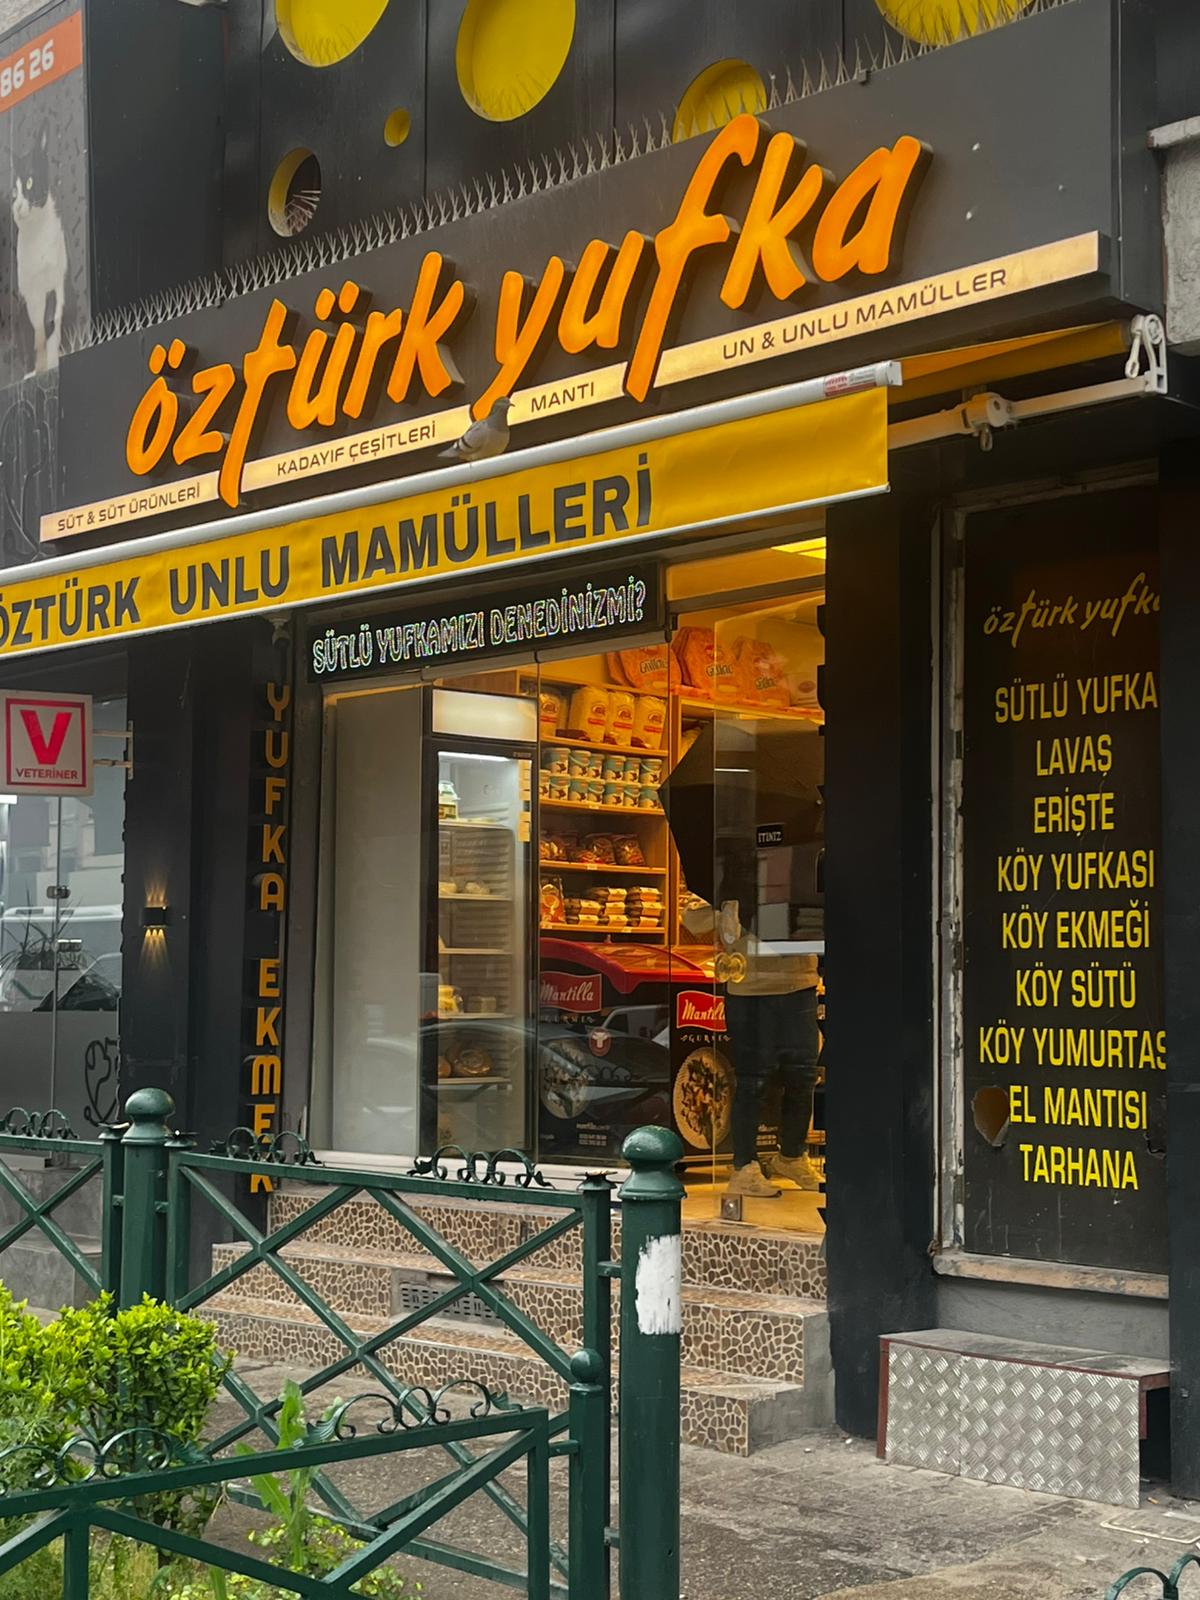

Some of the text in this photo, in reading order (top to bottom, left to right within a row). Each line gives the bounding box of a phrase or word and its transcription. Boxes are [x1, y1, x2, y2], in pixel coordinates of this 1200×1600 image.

[1, 39, 55, 98] 86 26
[126, 113, 921, 508] öztürk yufka
[723, 268, 1008, 360] UN & UNLU MAMÜLLER
[530, 382, 595, 413] MANTI
[277, 420, 436, 476] KADAYIF ÇEŞİTLERİ
[57, 481, 201, 532] SÜT & SÜT ÜRÜNLERİ
[168, 545, 290, 616] UNLU
[321, 452, 652, 588] MAMÜLLERİ
[312, 623, 373, 675] SÜTLÜ
[376, 610, 485, 664] YUFKAMIZI
[983, 588, 1079, 649] öztürk
[995, 671, 1158, 723] SÜTLÜ YUFKA
[20, 709, 73, 765] V
[1036, 734, 1112, 777] LAVAŞ
[16, 767, 78, 780] VETERİNER
[260, 682, 290, 912] YUFKA
[1033, 786, 1115, 837] ERİŞTE
[998, 847, 1154, 892] KÖY YUFKASI
[1002, 899, 1149, 949] KÖY EKMEĞİ
[540, 980, 594, 1002] Mantilla
[681, 998, 726, 1021] Mantill
[1016, 961, 1136, 1009] KÖY SÜTÜ
[979, 1019, 1025, 1064] KÖY
[1009, 1085, 1148, 1130] EL MANTISI
[1019, 1143, 1139, 1191] TARHANA
